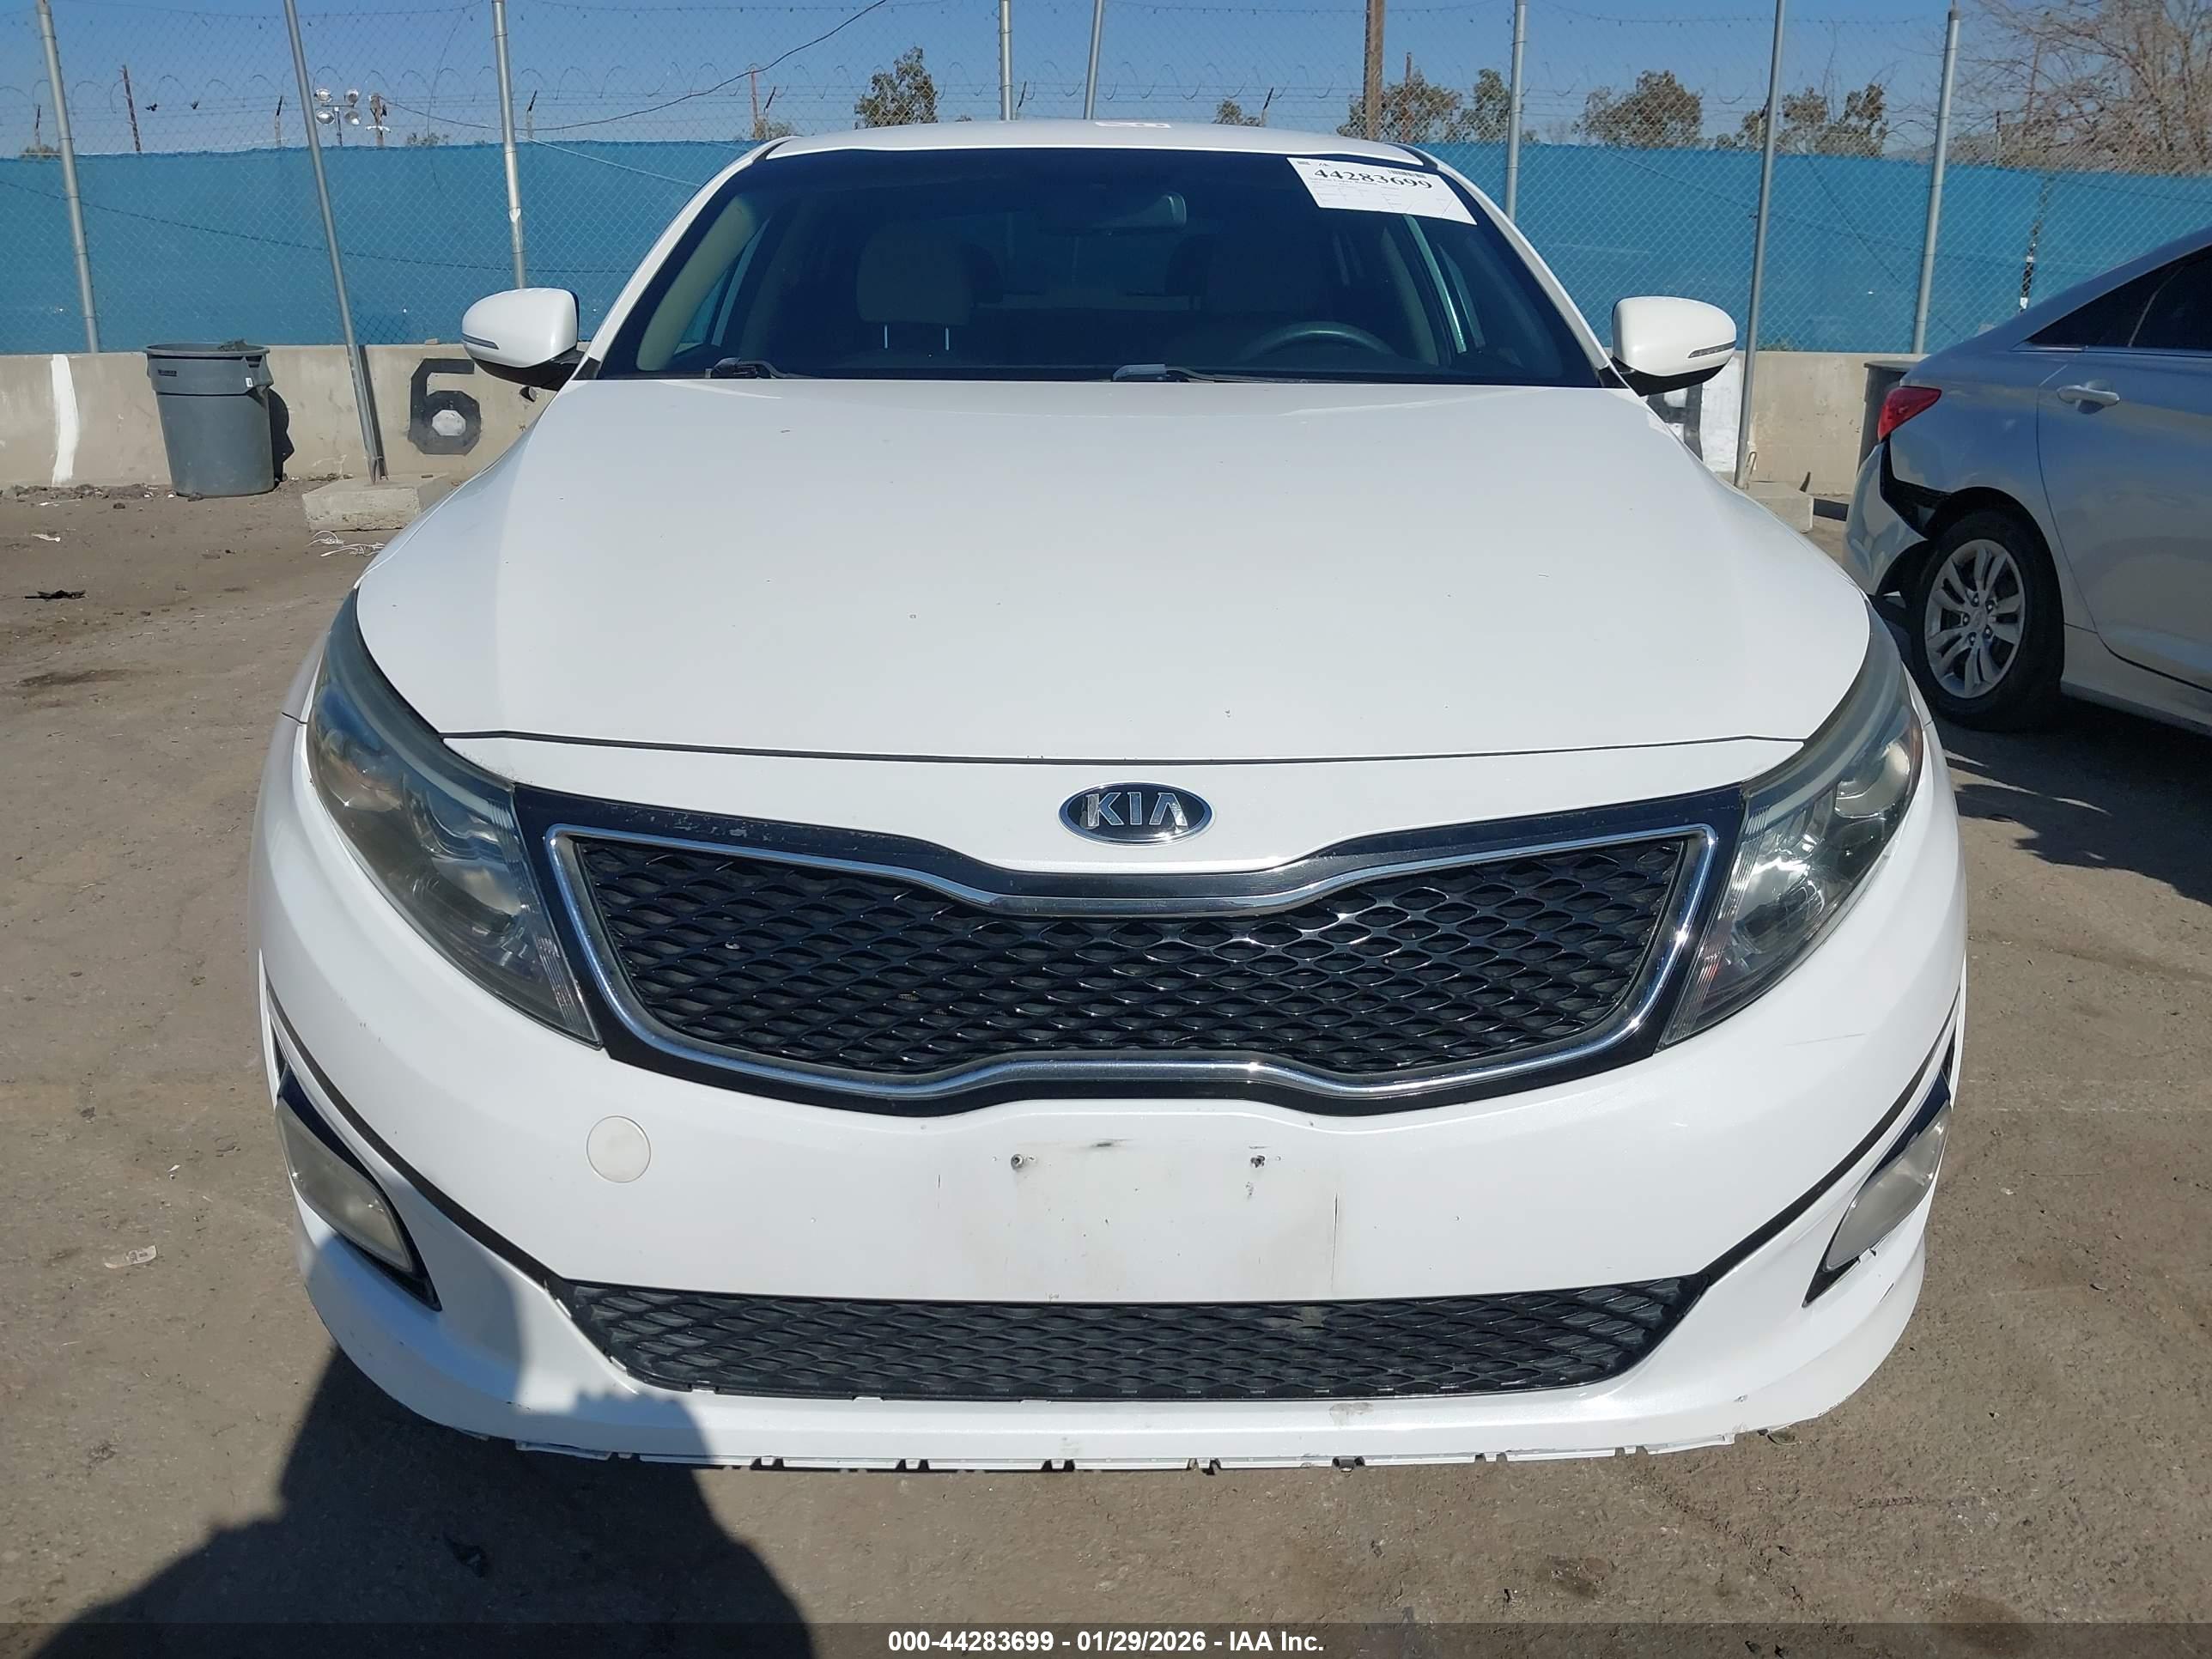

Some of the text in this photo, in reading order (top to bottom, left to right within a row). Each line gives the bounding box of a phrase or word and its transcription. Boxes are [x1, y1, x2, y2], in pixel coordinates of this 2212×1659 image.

[1314, 168, 1432, 189] 44283699
[407, 357, 482, 456] 6
[1085, 791, 1188, 827] KIA
